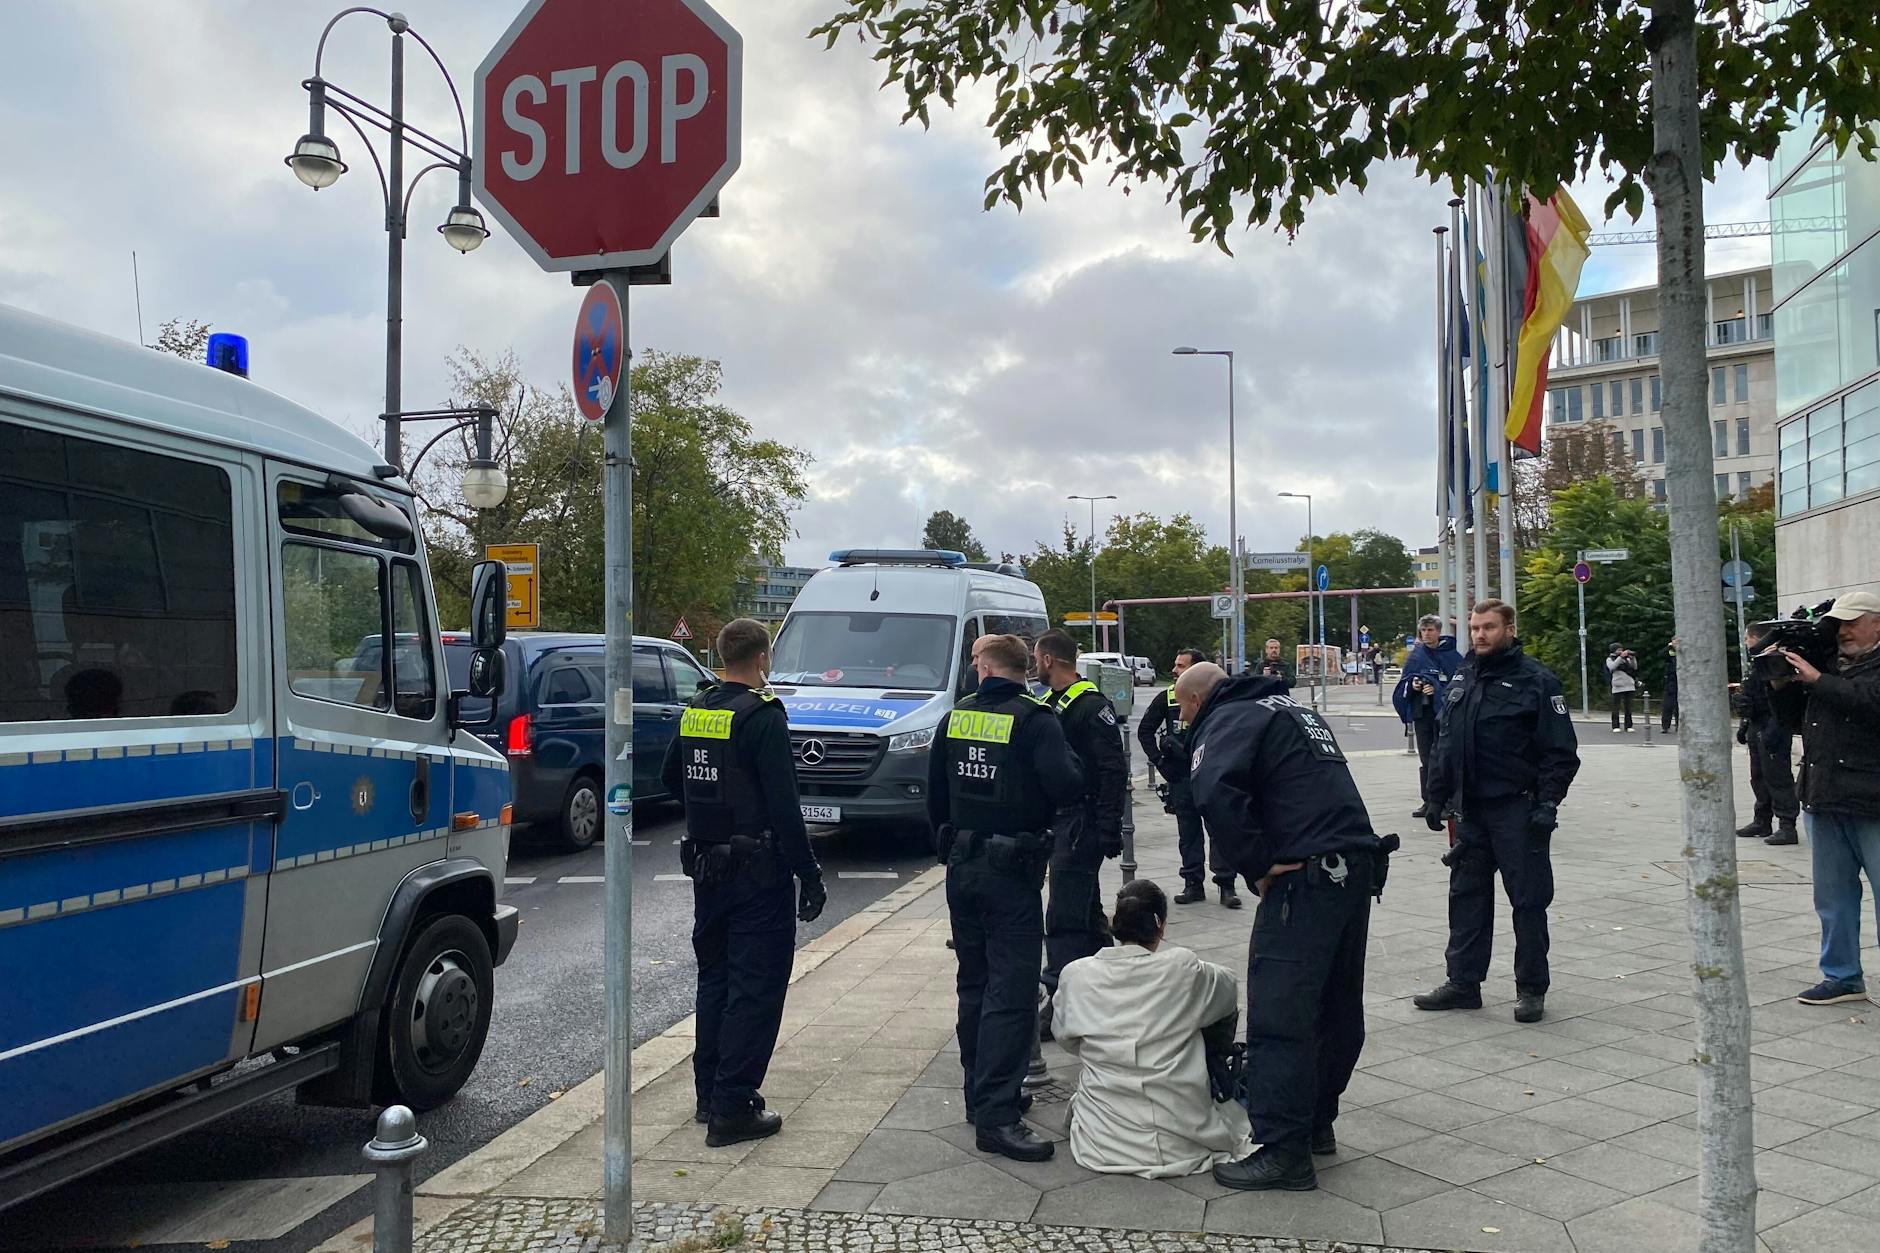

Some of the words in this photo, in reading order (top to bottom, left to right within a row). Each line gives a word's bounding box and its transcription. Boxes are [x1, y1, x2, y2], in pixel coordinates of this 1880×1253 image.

[501, 53, 709, 181] STOP
[784, 702, 871, 715] POLIZEI
[682, 711, 730, 734] POLIZEI
[949, 712, 1013, 741] POLIZEI
[1301, 713, 1319, 727] BE
[694, 749, 709, 764] BE
[968, 746, 986, 762] BE
[686, 764, 718, 781] 31218
[957, 761, 997, 780] 31137
[802, 806, 832, 818] 31543
